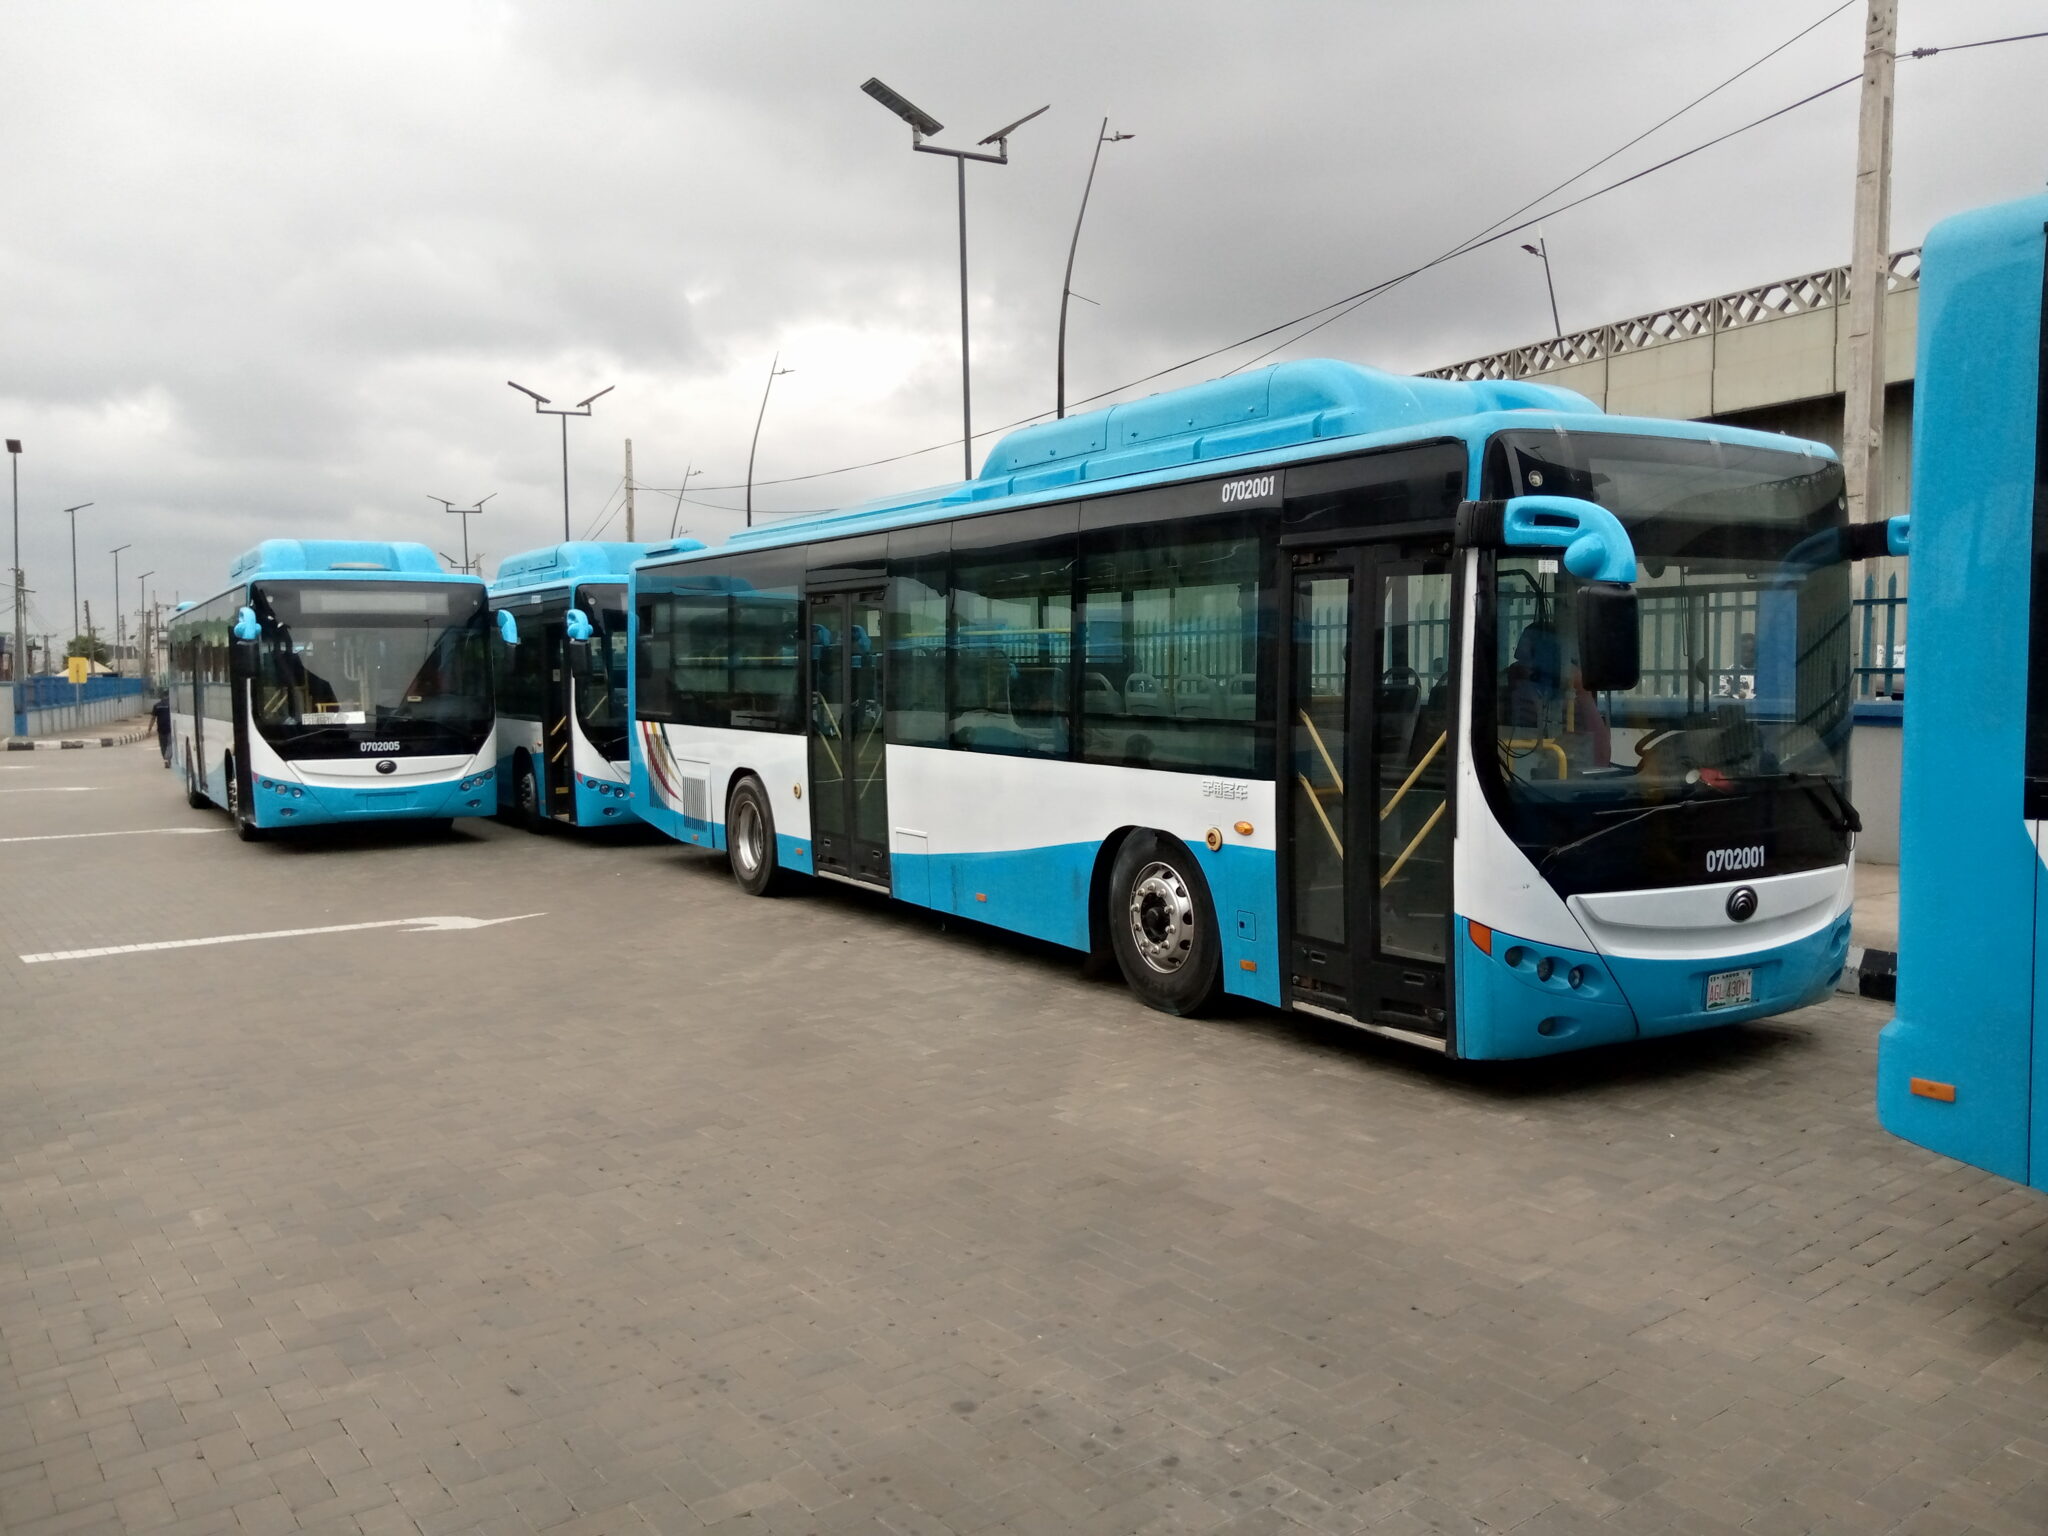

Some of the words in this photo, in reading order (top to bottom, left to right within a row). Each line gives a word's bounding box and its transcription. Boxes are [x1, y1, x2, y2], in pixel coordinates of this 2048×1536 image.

[1221, 475, 1275, 503] 0702001
[360, 741, 401, 752] 0702005
[1202, 780, 1249, 801] 宇通客车
[1706, 845, 1765, 873] 0702001
